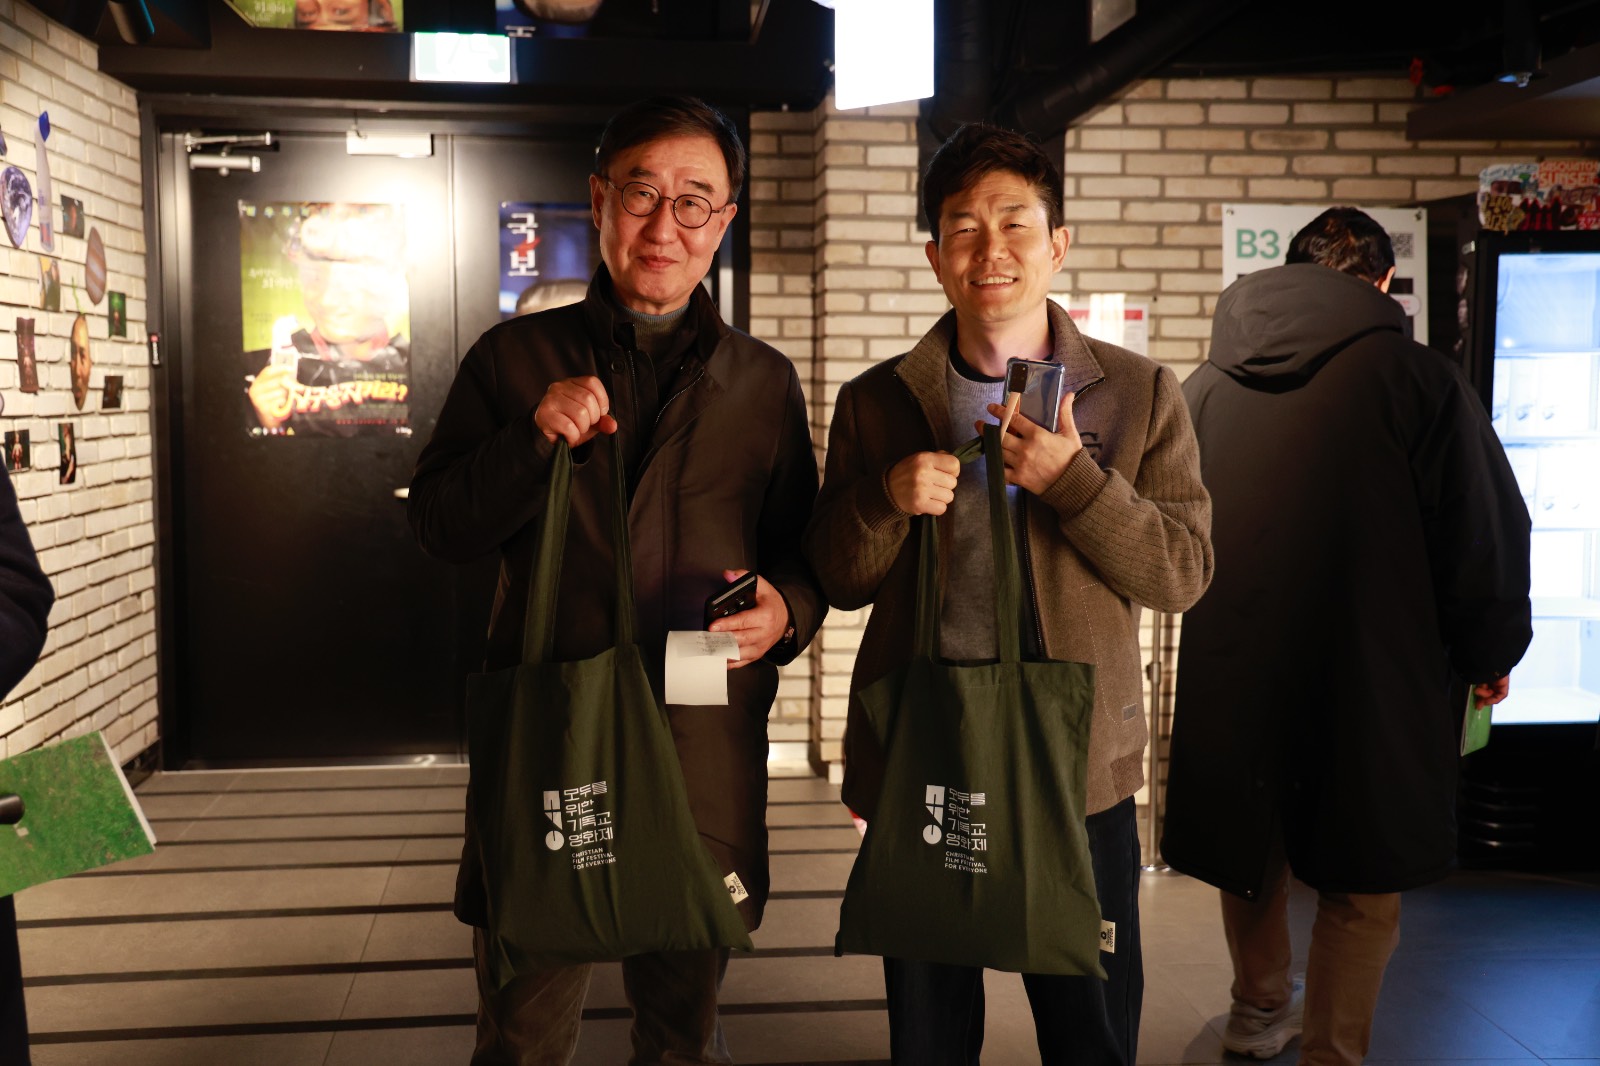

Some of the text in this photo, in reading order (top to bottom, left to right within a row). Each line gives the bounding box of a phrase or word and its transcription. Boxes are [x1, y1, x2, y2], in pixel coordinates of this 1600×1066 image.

[1540, 171, 1597, 188] SUNSET
[507, 212, 539, 277] 국보
[1236, 228, 1280, 260] B3
[564, 781, 607, 801] 모두를
[949, 787, 985, 806] 모두를
[565, 799, 594, 816] 위한
[949, 803, 970, 820] 위한
[567, 811, 611, 831] 기독교
[948, 817, 986, 835] 기독교
[569, 827, 613, 847] 영화제
[946, 833, 986, 851] 영화제
[572, 847, 603, 858] CHRISTIAN
[586, 852, 613, 861] FESTIVAL
[945, 851, 974, 861] CHRISTIAN
[586, 857, 616, 868] EVERYONE
[958, 864, 987, 873] EVERYONE
[960, 860, 985, 868] FESTIVAL
